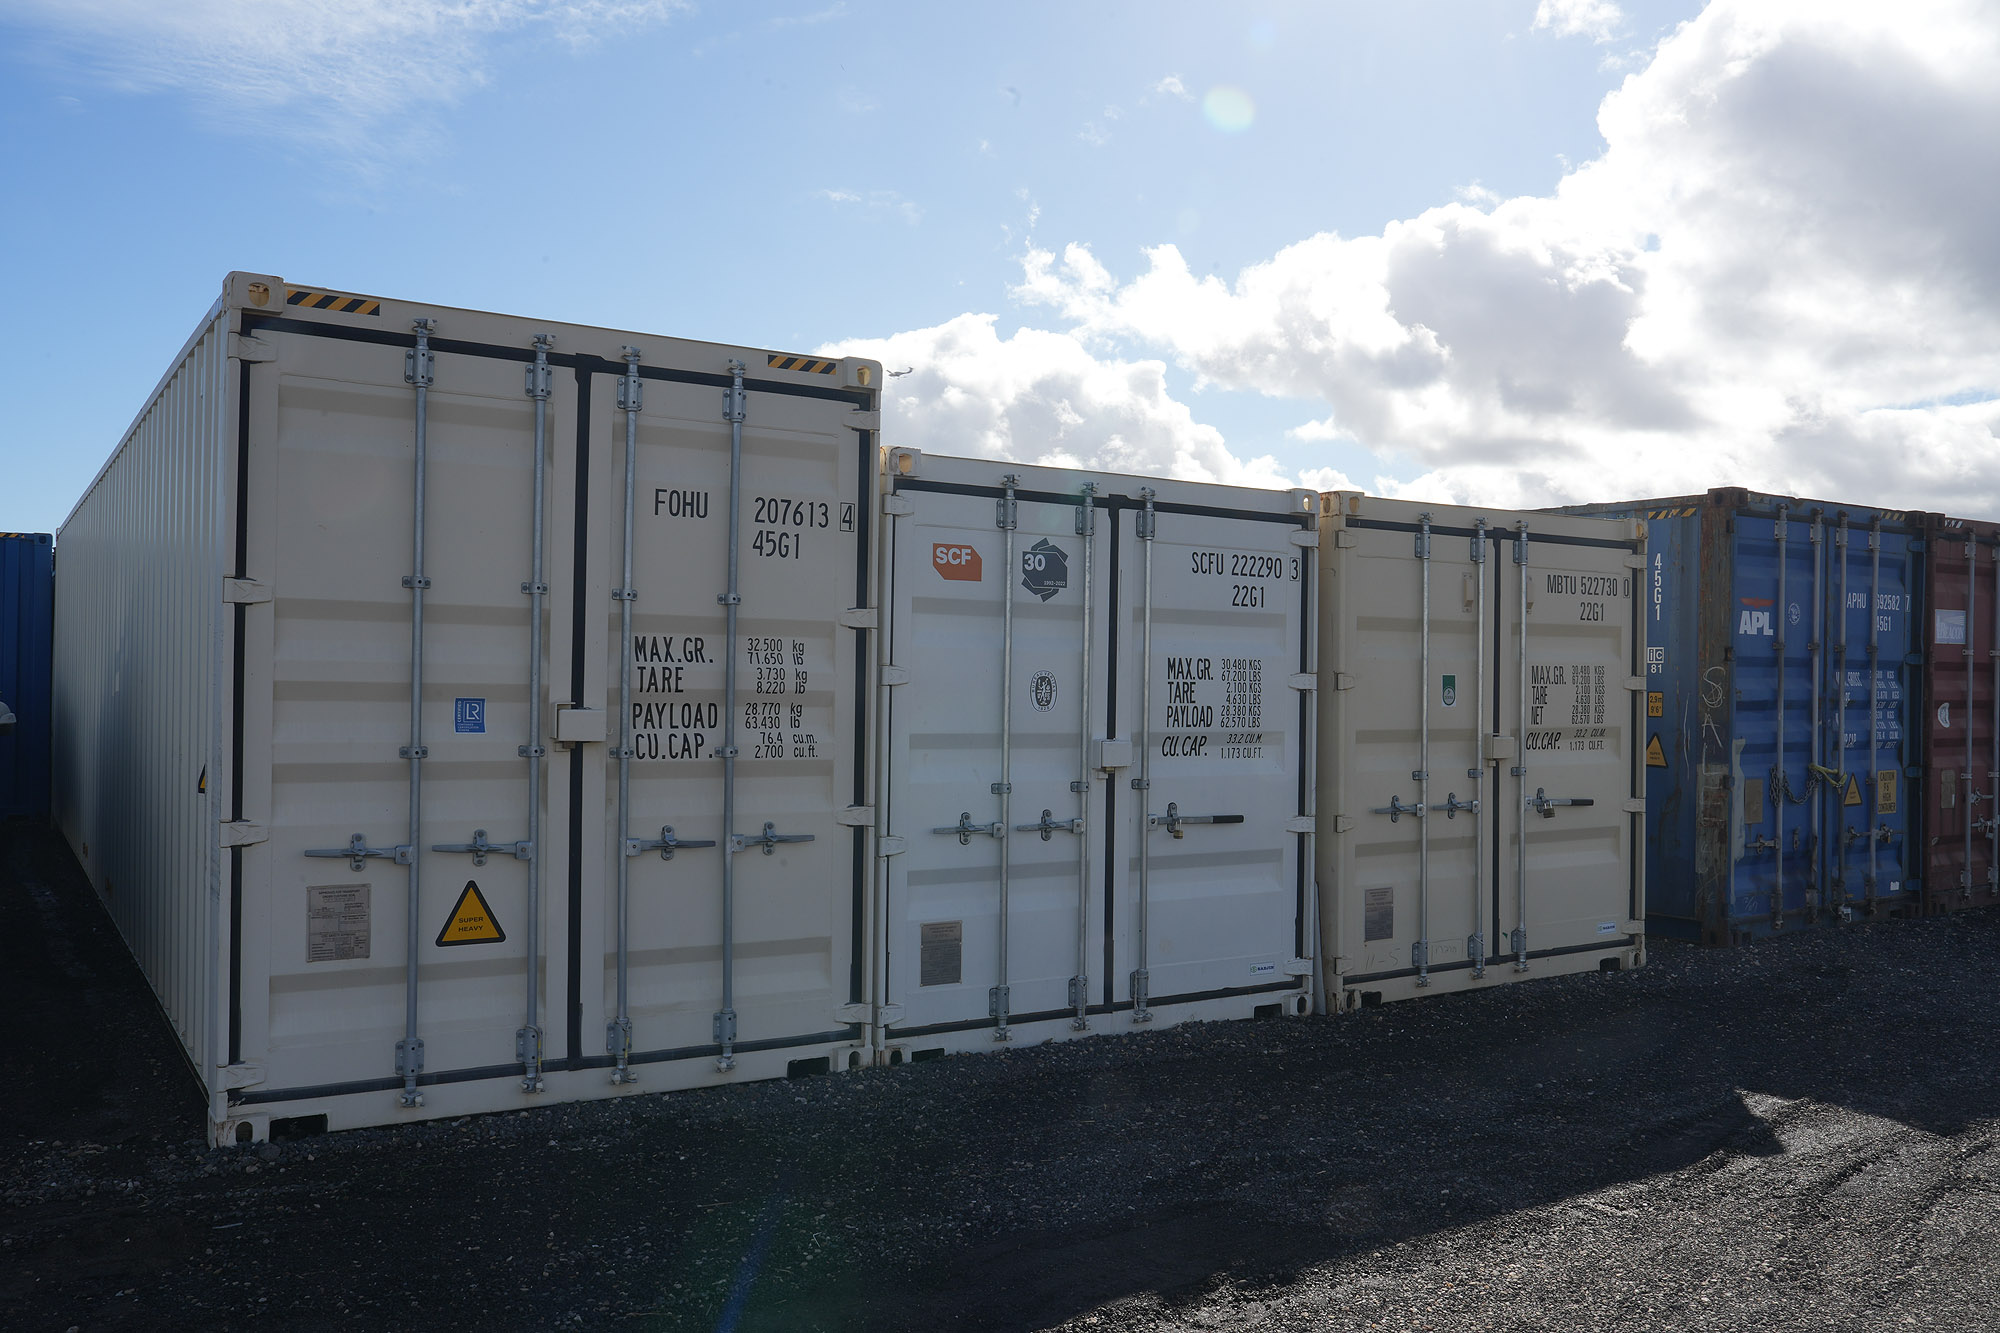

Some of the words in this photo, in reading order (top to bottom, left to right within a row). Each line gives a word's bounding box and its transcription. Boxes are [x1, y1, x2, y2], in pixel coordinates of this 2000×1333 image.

[655, 488, 708, 518] FOHU
[754, 497, 829, 528] 207613
[841, 503, 854, 531] 4
[752, 530, 800, 560] 45G1
[936, 546, 972, 566] SCF
[1024, 554, 1046, 572] 30
[1192, 552, 1224, 576] SCFU
[1231, 554, 1282, 579] 222290
[1291, 558, 1299, 580] 3
[1547, 574, 1577, 595] MBTU
[1580, 576, 1618, 597] 522730
[1654, 552, 1662, 620] 45G1
[1232, 585, 1264, 608] 22G1
[1846, 592, 1867, 609] APHU
[1905, 595, 1910, 611] 7
[1580, 602, 1604, 622] 22G1
[1738, 610, 1774, 636] APL
[634, 635, 714, 664] MAX.GR.
[747, 638, 783, 652] 32.500
[792, 640, 805, 656] kg
[748, 652, 784, 666] 71.650
[792, 653, 804, 666] lb
[1167, 658, 1214, 680] MAX.GR.
[1221, 658, 1247, 670] 30.480
[1248, 659, 1262, 670] KGS
[1221, 670, 1247, 682] 67.200
[1248, 670, 1262, 682] LBS
[1531, 665, 1567, 685] MAX.GR.
[1594, 665, 1605, 675] KGS
[1650, 664, 1662, 674] 81
[636, 666, 684, 693] TARE
[756, 668, 786, 682] 3.730
[795, 668, 808, 684] kg
[756, 681, 786, 695] 8.220
[794, 682, 806, 695] lb
[1594, 675, 1605, 684] LBS
[1168, 682, 1196, 704] TARE
[1226, 682, 1247, 694] 2.100
[1248, 682, 1262, 694] KGS
[1226, 694, 1247, 705] 4.630
[1248, 694, 1261, 705] LBS
[1532, 685, 1548, 704] TARE
[1575, 685, 1591, 694] 2.100
[1594, 685, 1606, 695] KGS
[1594, 695, 1605, 704] LBS
[466, 703, 480, 720] LR
[632, 702, 718, 730] PAYLOAD
[744, 702, 781, 716] 28.770
[790, 703, 802, 718] kg
[1166, 706, 1213, 728] PAYLOAD
[1220, 705, 1246, 716] 28.380
[1248, 705, 1262, 717] KGS
[1531, 706, 1544, 725] NET
[1594, 705, 1605, 714] KGS
[1594, 715, 1604, 724] LBS
[744, 716, 780, 730] 63.430
[790, 716, 800, 729] lb
[1220, 717, 1246, 728] 62.570
[1248, 717, 1260, 728] LBS
[760, 731, 783, 745] 76.4
[792, 733, 818, 744] cu.m.
[1226, 733, 1244, 744] 33.2
[1574, 728, 1588, 738] 33.2
[754, 745, 784, 759] 2.700
[794, 745, 818, 758] cu.ft.
[1221, 747, 1240, 759] 1.173
[1242, 747, 1264, 759] CU.FT.
[1569, 741, 1585, 751] 1.173
[458, 916, 484, 924] SUPER
